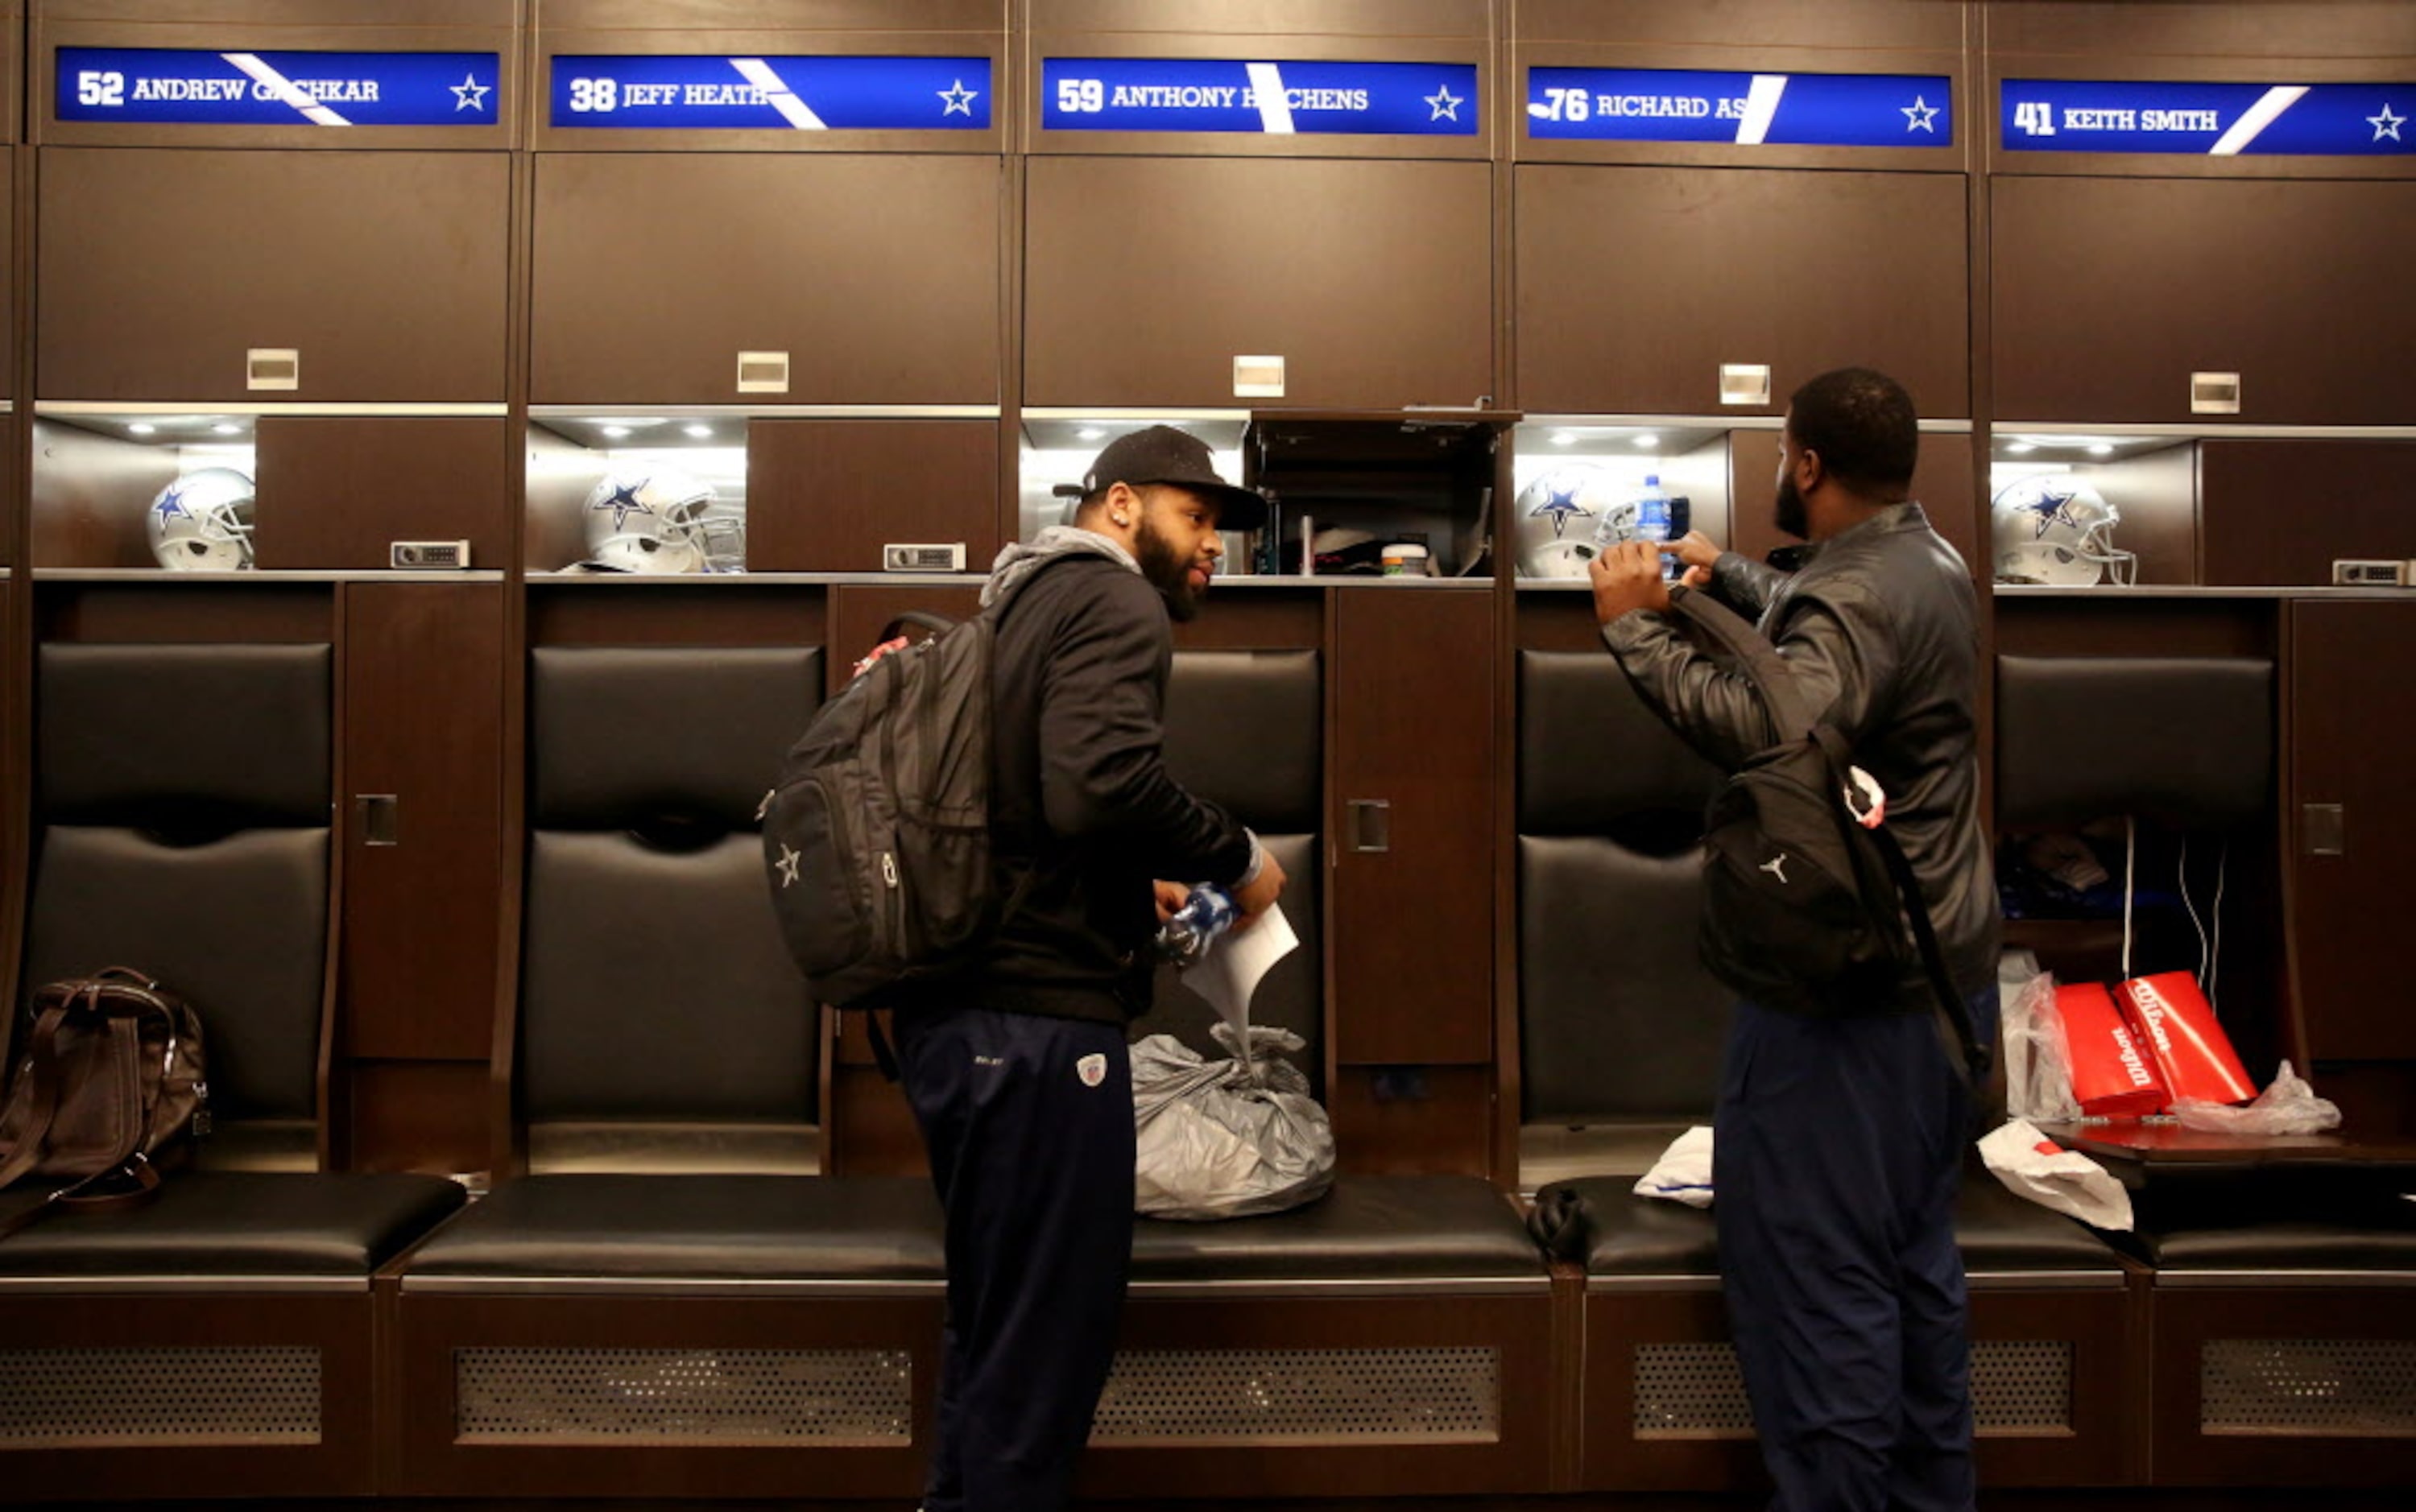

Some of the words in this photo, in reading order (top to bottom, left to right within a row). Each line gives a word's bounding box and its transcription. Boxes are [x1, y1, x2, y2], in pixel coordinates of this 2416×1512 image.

[79, 72, 124, 105] 52
[132, 79, 246, 101] ANDREW
[251, 80, 379, 101] GCHKAR
[569, 78, 618, 112] 38
[623, 84, 681, 107] JEFF
[683, 84, 767, 105] HEATH
[1057, 79, 1103, 112] 59
[1110, 85, 1237, 108] ANTHONY
[1241, 87, 1369, 110] HCHENS
[1545, 89, 1589, 122] 76
[1597, 95, 1710, 118] RICHARD
[1715, 98, 1747, 119] AS
[2014, 102, 2056, 136] 41
[2063, 109, 2137, 131] KEITH
[2141, 109, 2219, 132] SMITH
[2133, 981, 2172, 1053] Wilson
[2111, 1026, 2153, 1086] Wilson
